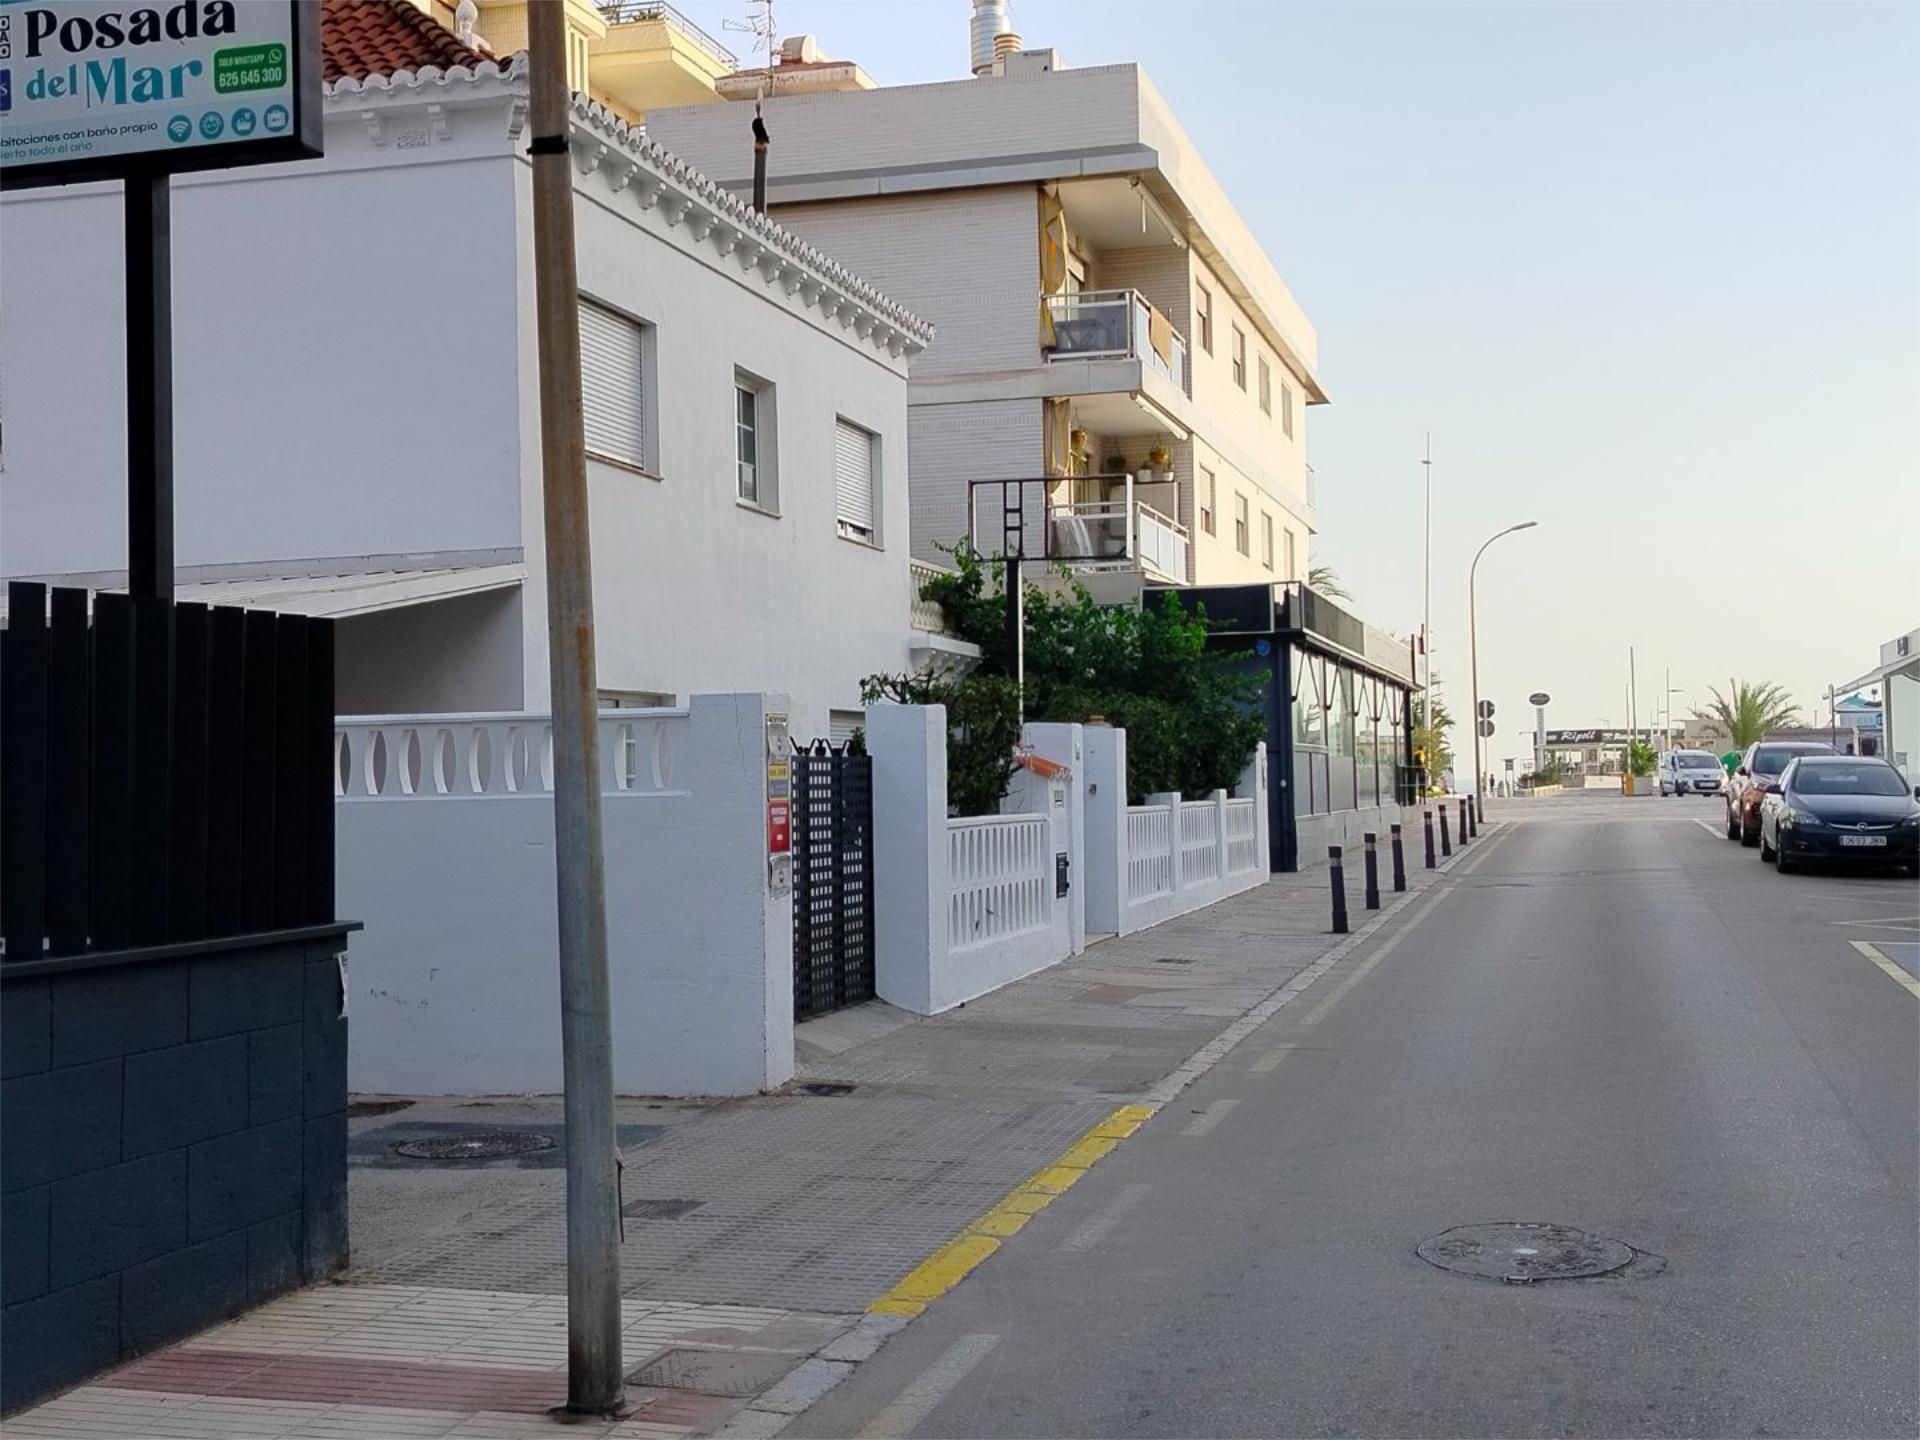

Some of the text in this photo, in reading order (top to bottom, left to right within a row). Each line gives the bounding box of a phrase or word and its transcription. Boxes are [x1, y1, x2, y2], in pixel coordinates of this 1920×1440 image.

[24, 0, 236, 57] Posada
[26, 57, 203, 109] del Mar
[219, 67, 282, 88] 625 645 300
[62, 130, 85, 141] con
[87, 125, 118, 138] baño
[120, 121, 158, 135] propio
[29, 146, 55, 156] todo
[58, 143, 68, 153] el
